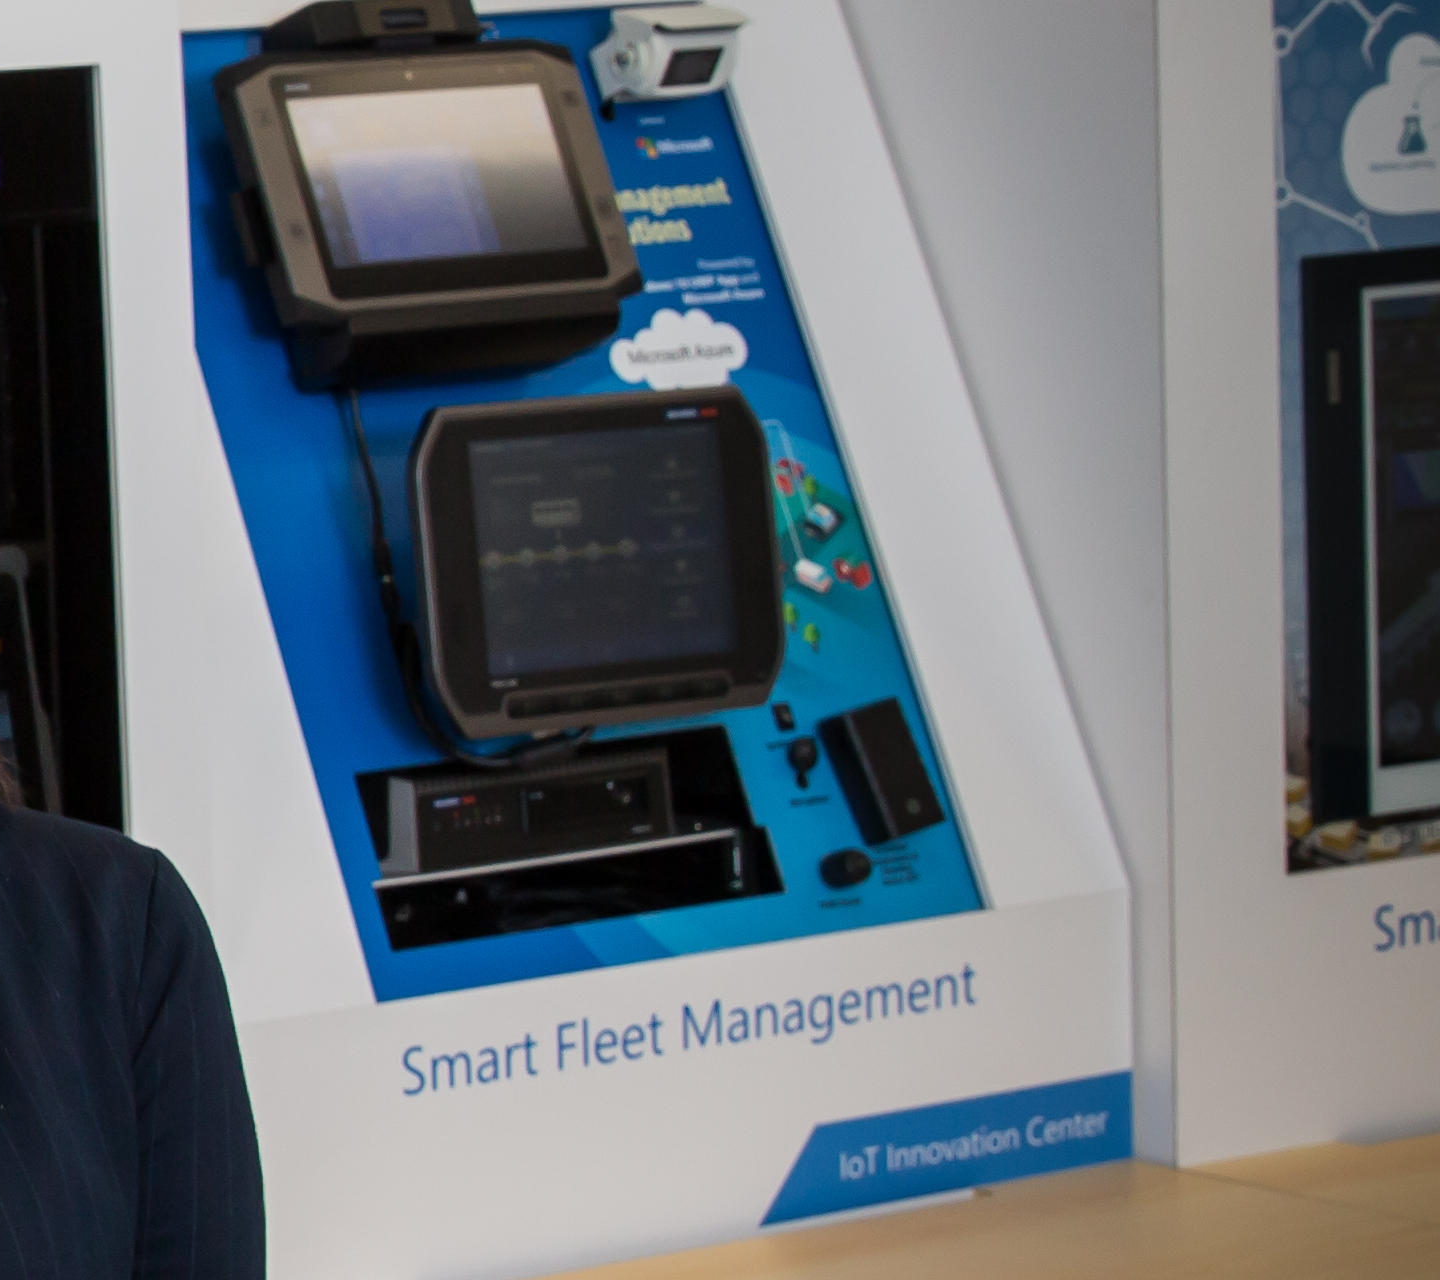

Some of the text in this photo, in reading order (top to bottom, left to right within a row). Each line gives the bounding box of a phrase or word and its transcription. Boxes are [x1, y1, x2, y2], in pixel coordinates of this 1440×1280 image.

[1372, 903, 1440, 952] Sm
[401, 962, 979, 1098] Smart Fleet Management
[838, 1109, 1109, 1180] IoT Innovation Center
